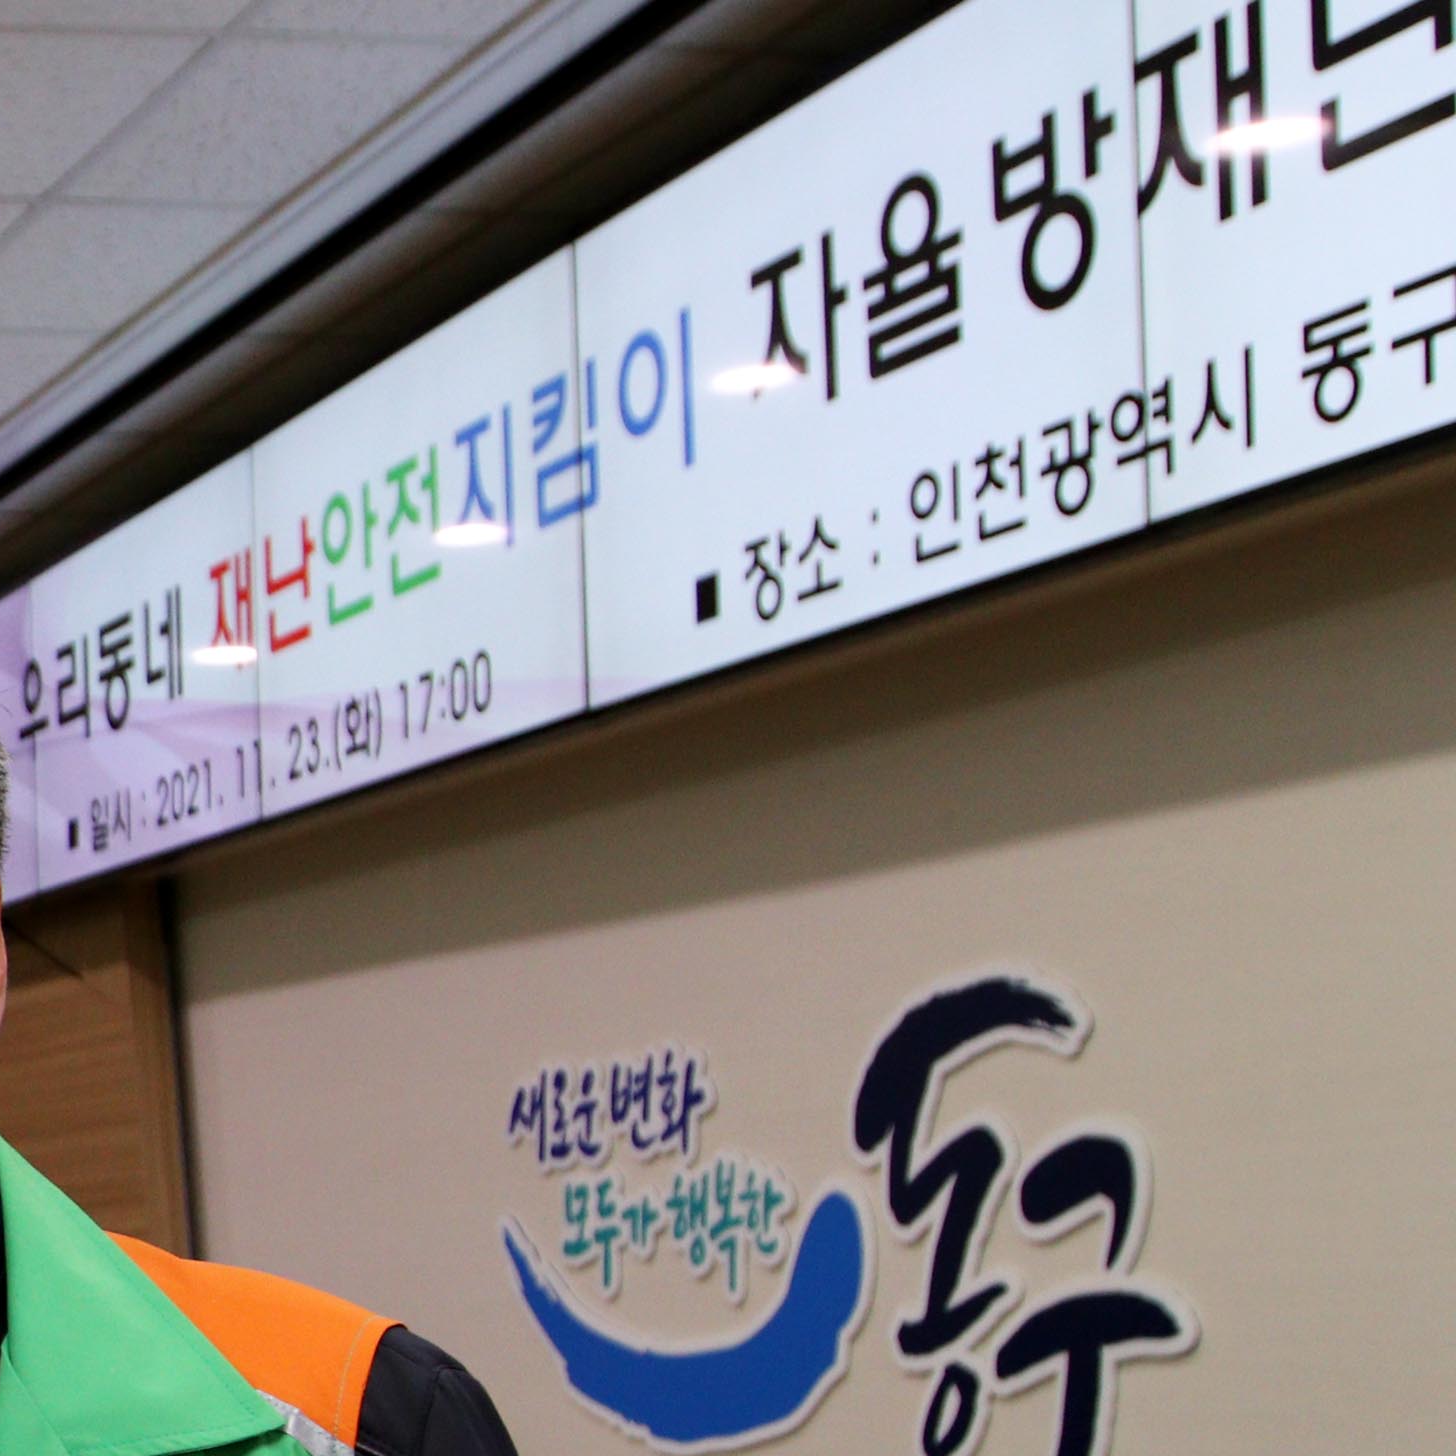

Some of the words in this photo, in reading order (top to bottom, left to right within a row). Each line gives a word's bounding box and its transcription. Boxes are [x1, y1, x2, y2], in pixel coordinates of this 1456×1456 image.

[19, 584, 184, 740] 우리동네
[209, 307, 695, 669] 재난안전지킴이
[744, 513, 843, 621] 장소
[909, 344, 1256, 565] 인천광역시
[1301, 264, 1456, 424] 동구
[89, 784, 132, 853] 일시
[399, 649, 493, 740] 17:00
[509, 1067, 601, 1162] 새로운
[609, 1048, 706, 1156] 변화
[563, 1182, 658, 1288] 모두가
[666, 1158, 785, 1293] 행복한
